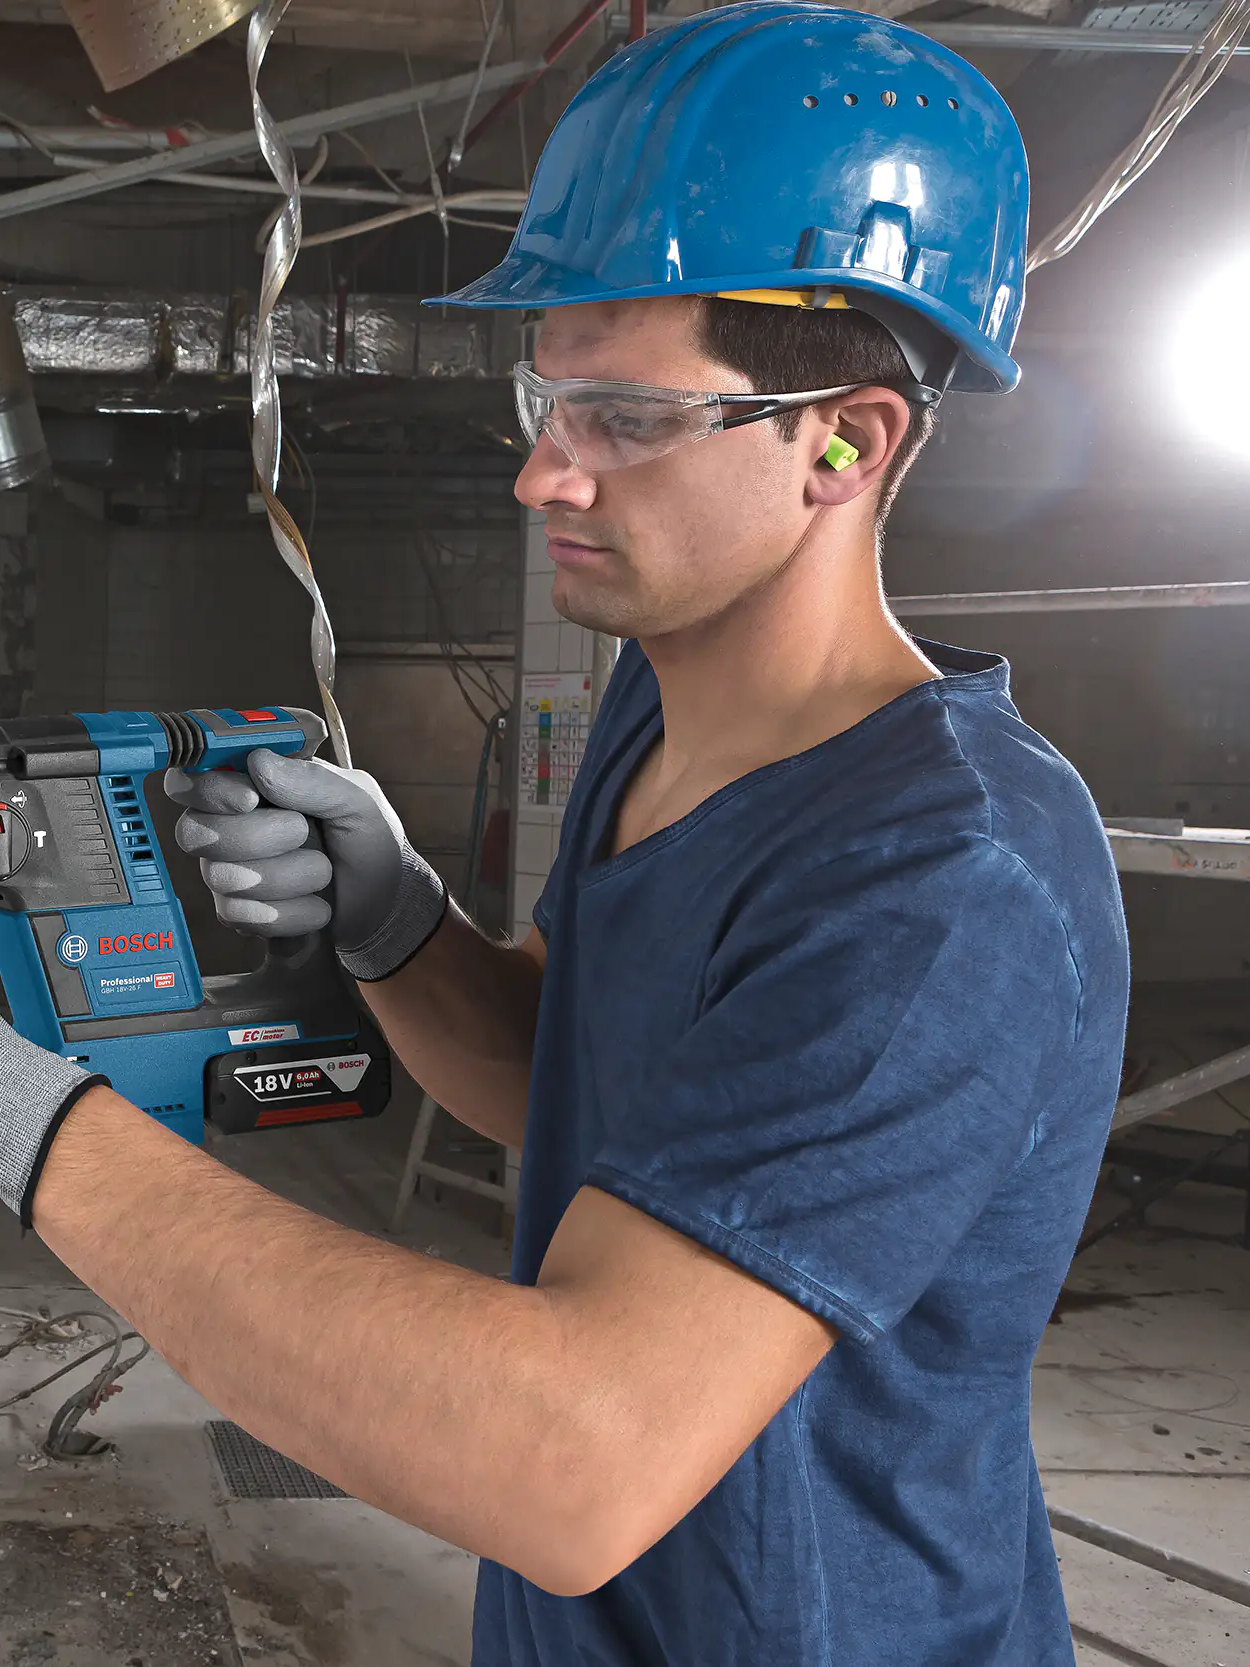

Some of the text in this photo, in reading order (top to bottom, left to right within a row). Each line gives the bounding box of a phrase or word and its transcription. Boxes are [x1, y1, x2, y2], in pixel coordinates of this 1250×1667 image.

[98, 931, 173, 955] BOSCH
[100, 974, 153, 987] Professional
[241, 1030, 260, 1043] EC
[338, 1060, 365, 1070] BOSCH
[253, 1073, 293, 1094] 18V
